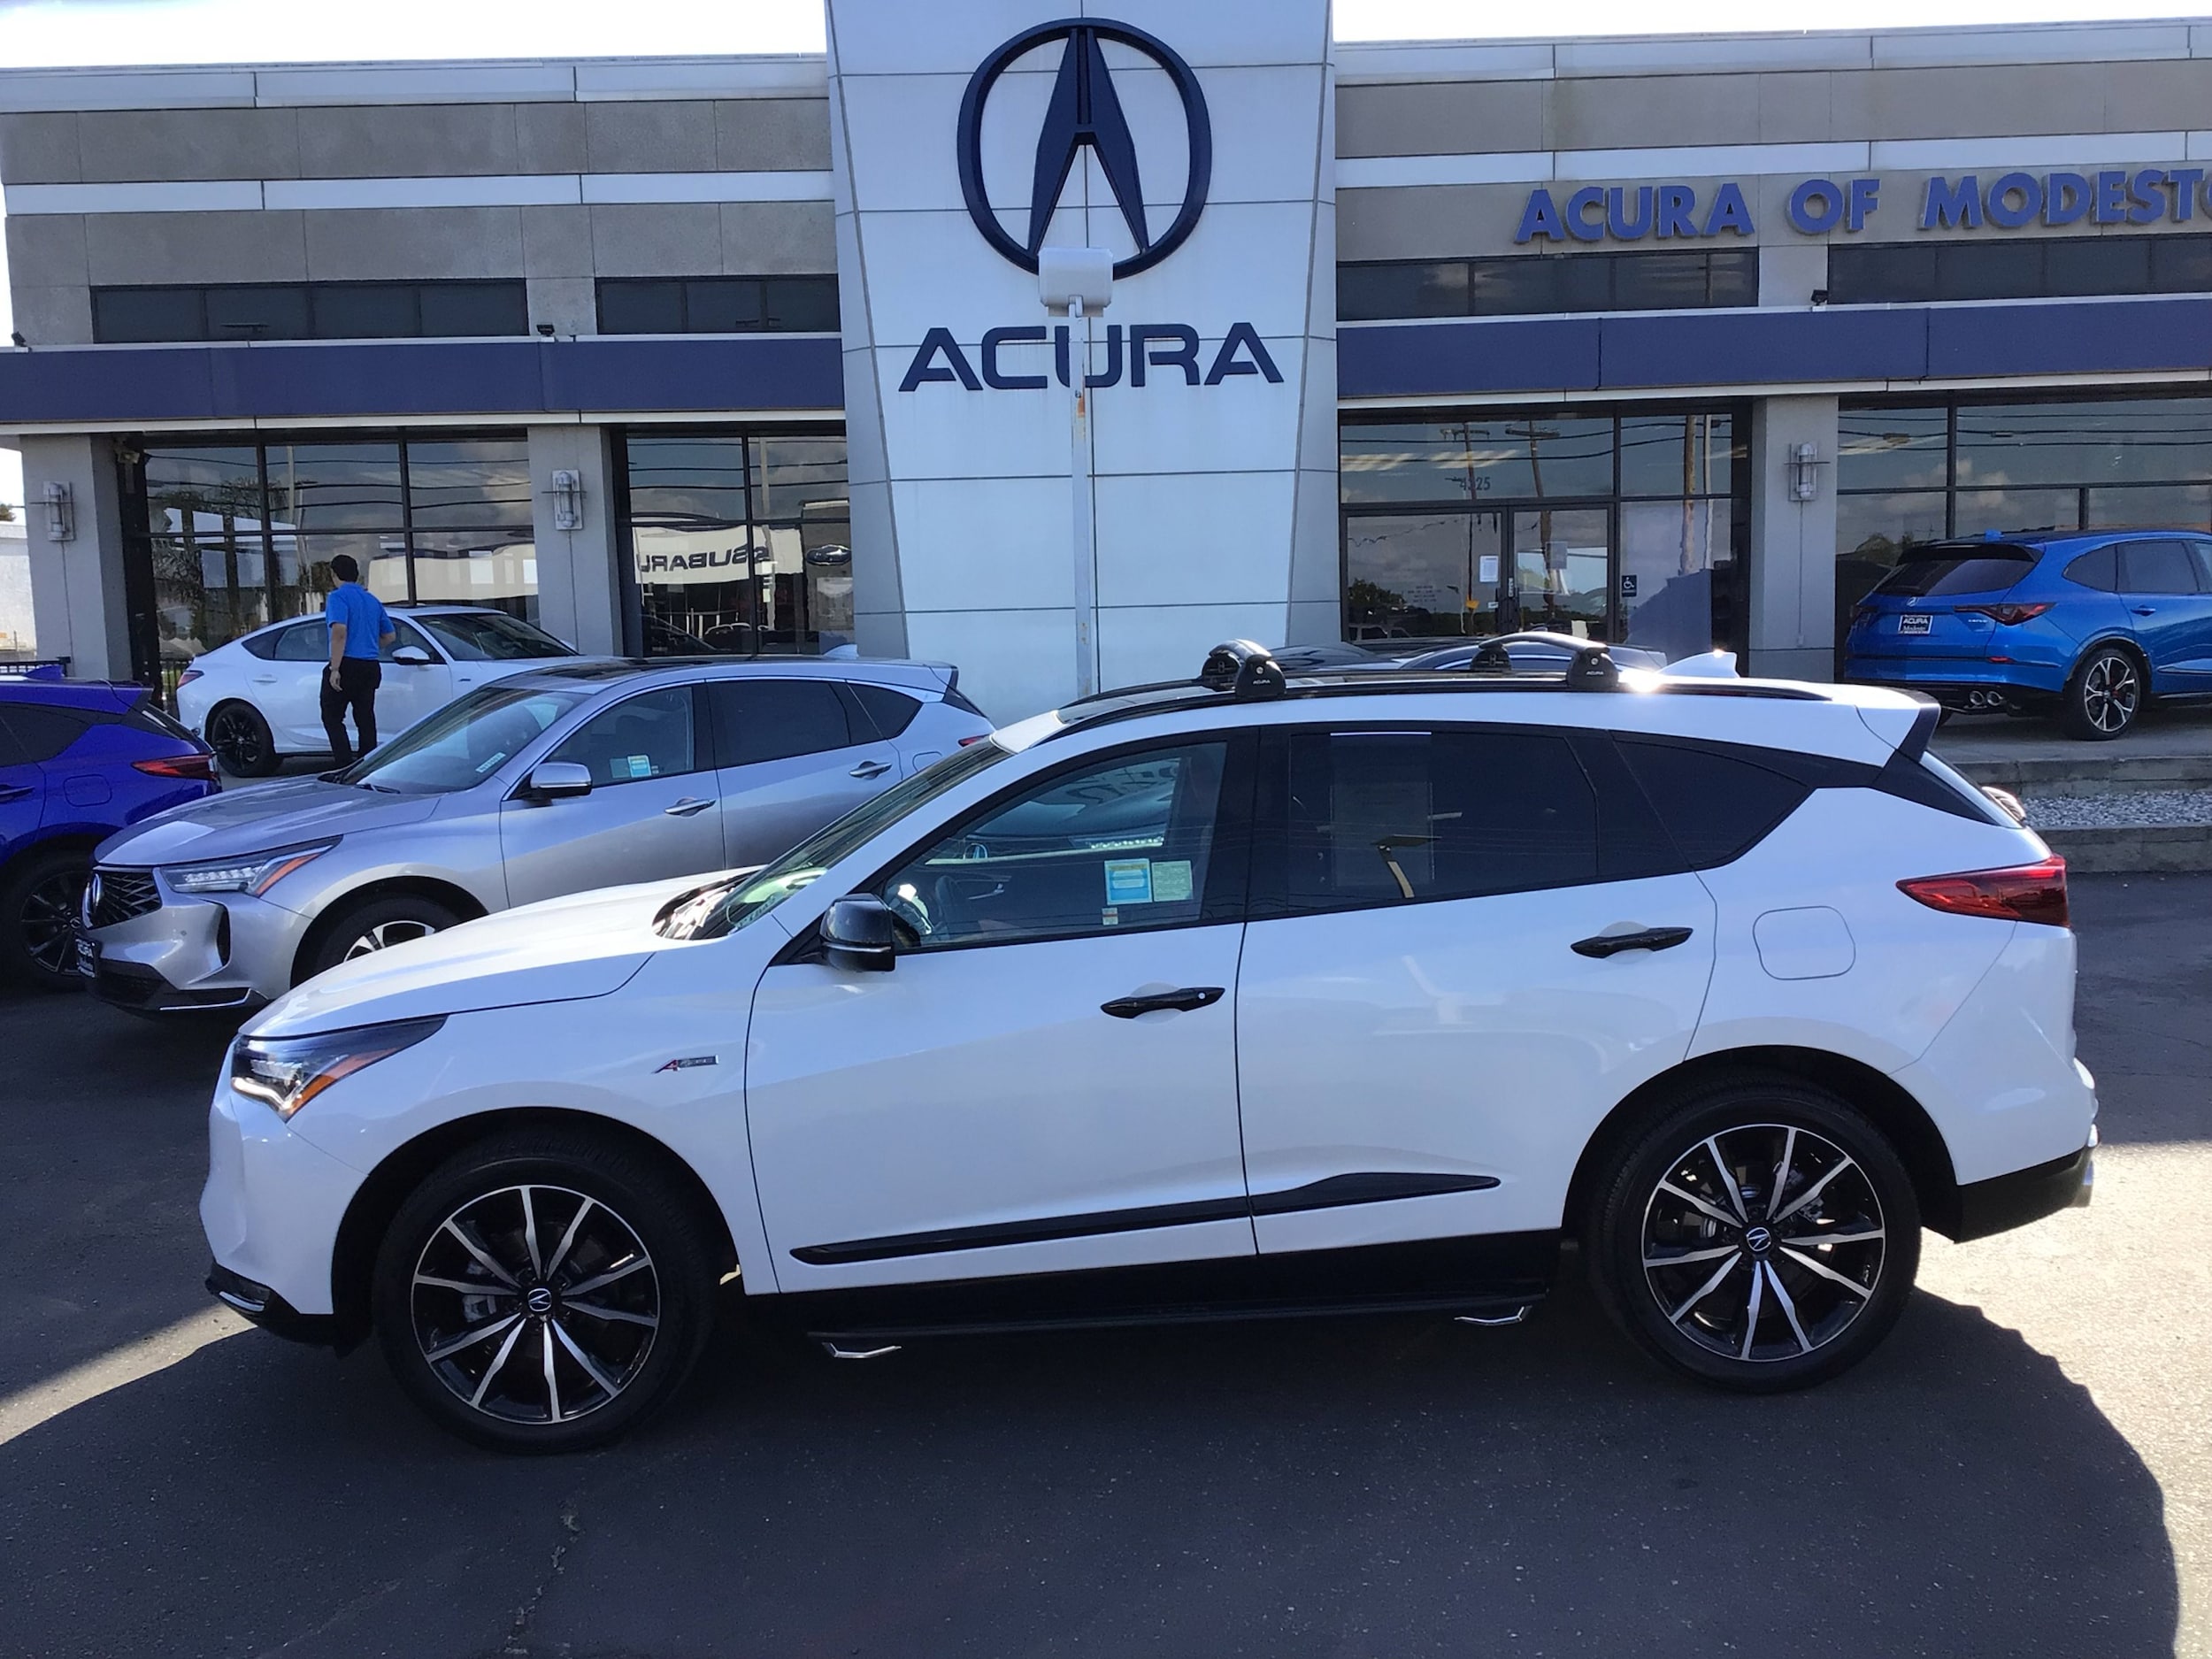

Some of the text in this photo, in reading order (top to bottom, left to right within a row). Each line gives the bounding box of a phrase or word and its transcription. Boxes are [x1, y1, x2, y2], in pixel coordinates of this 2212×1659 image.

[1514, 167, 2212, 243] ACURA OF MODEST
[898, 322, 1285, 392] ACURA
